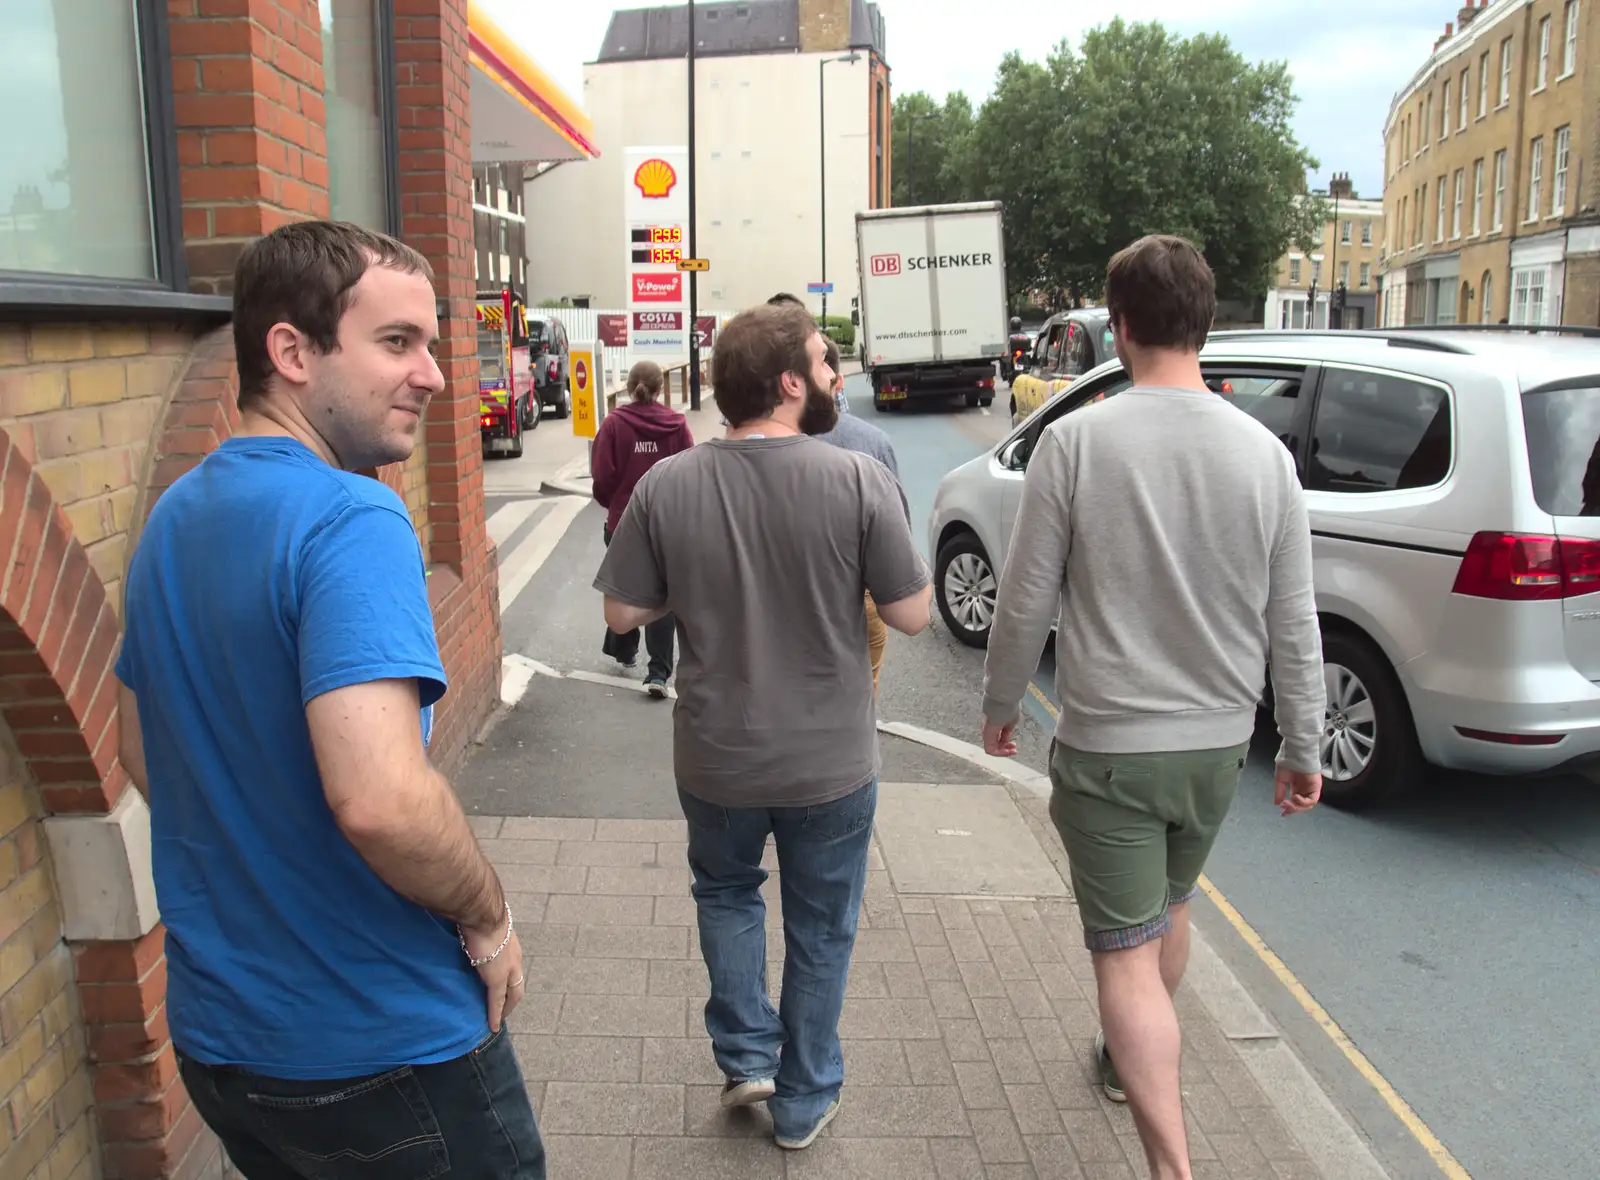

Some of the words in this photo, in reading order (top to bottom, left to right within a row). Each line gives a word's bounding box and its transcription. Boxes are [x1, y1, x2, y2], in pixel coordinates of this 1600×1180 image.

[650, 228, 681, 242] 129.9
[875, 257, 897, 273] DB
[907, 253, 992, 270] SCHENKER
[639, 313, 676, 323] COSTA
[875, 328, 967, 340] www.dbschenker.com
[634, 441, 658, 453] ANITA
